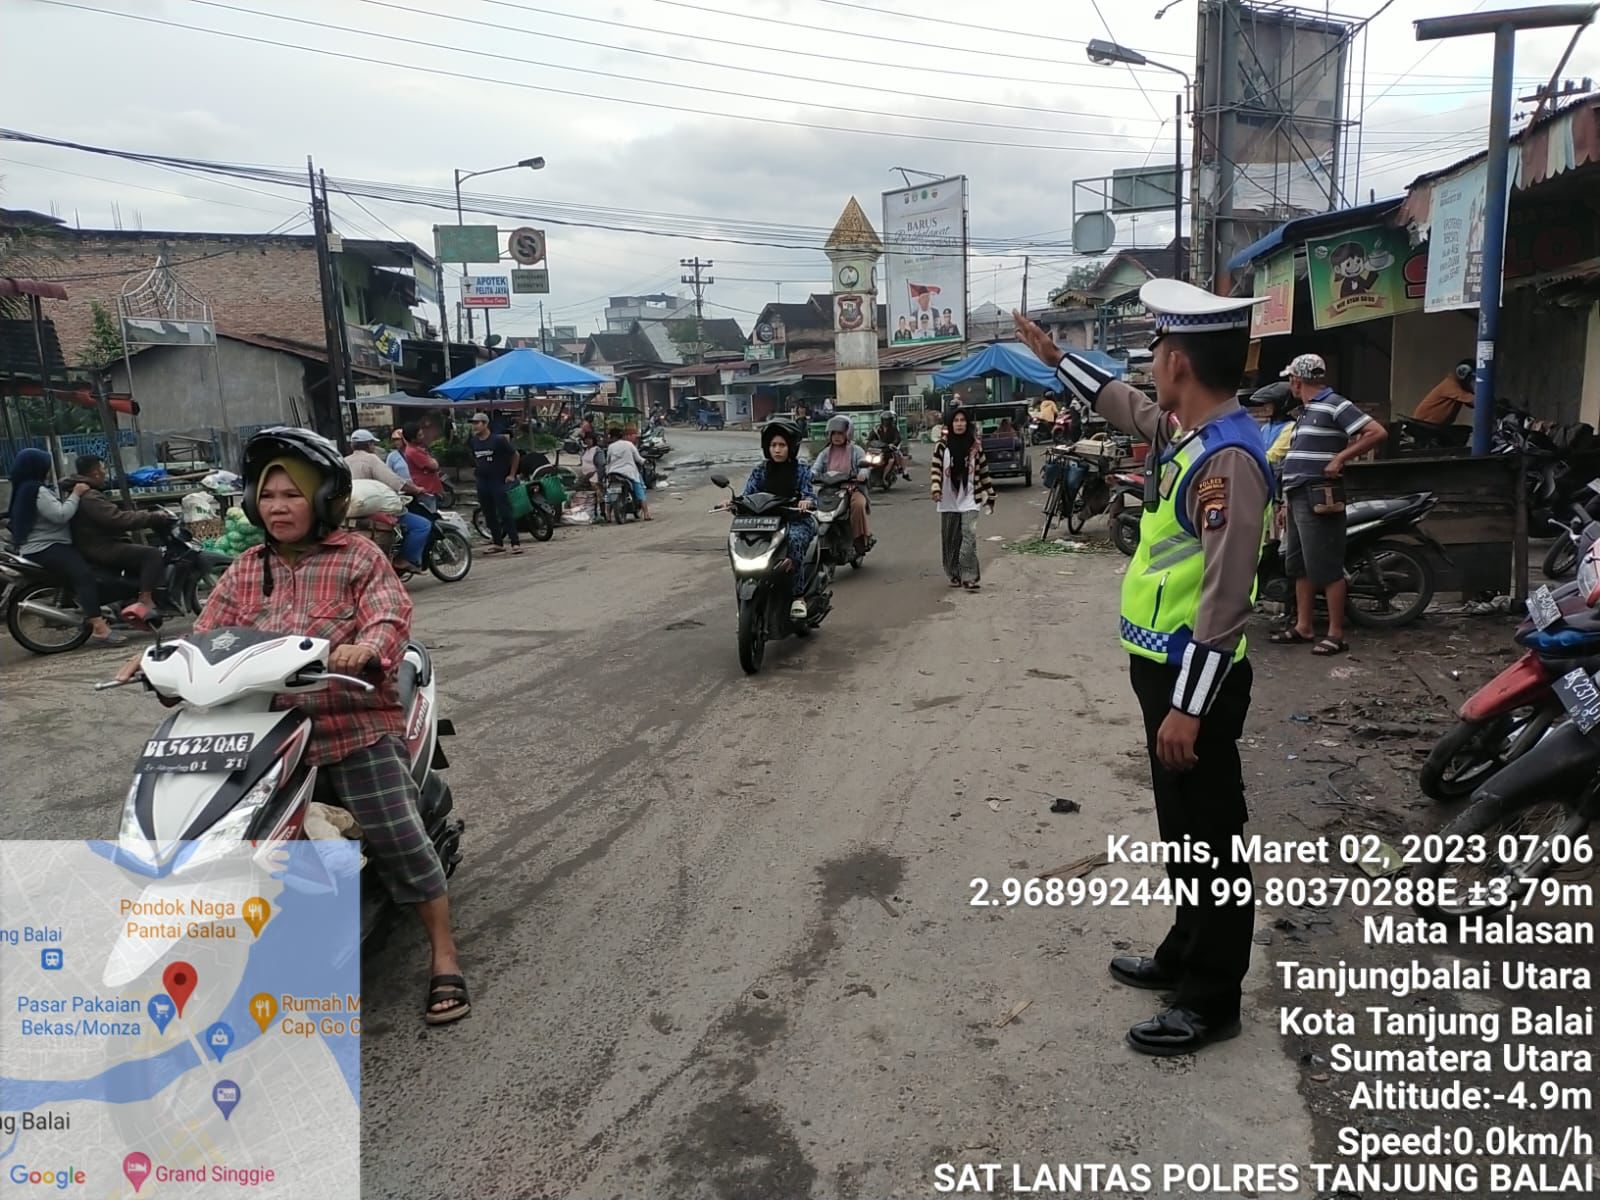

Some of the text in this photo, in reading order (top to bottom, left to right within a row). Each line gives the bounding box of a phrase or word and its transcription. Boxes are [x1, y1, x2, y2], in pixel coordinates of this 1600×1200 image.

[907, 217, 938, 231] BARUS
[476, 276, 506, 286] APOTEK
[475, 286, 494, 295] PELITA
[494, 286, 507, 295] JAYA
[143, 740, 169, 758] BK
